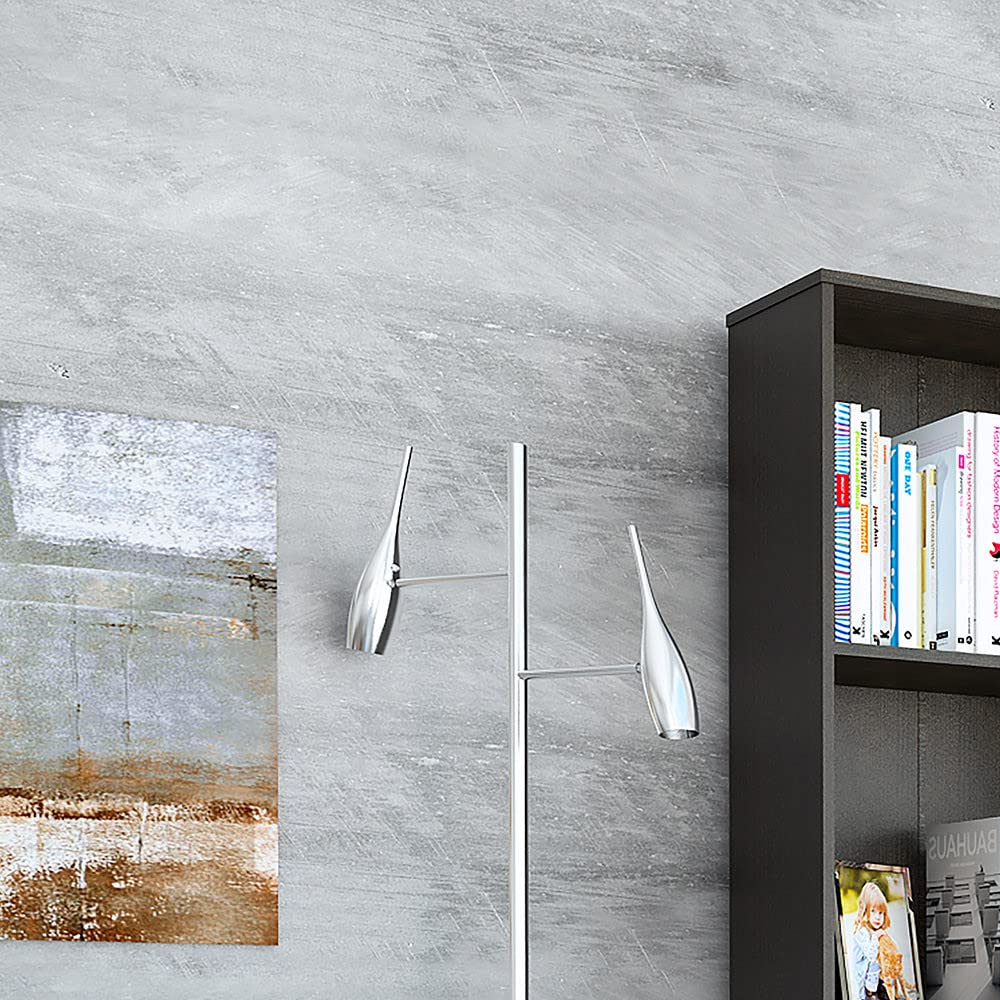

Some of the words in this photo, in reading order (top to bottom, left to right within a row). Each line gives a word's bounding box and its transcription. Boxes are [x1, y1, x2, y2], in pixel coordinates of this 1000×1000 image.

[992, 426, 1000, 455] History
[993, 458, 1000, 467] of
[992, 504, 1000, 534] Design
